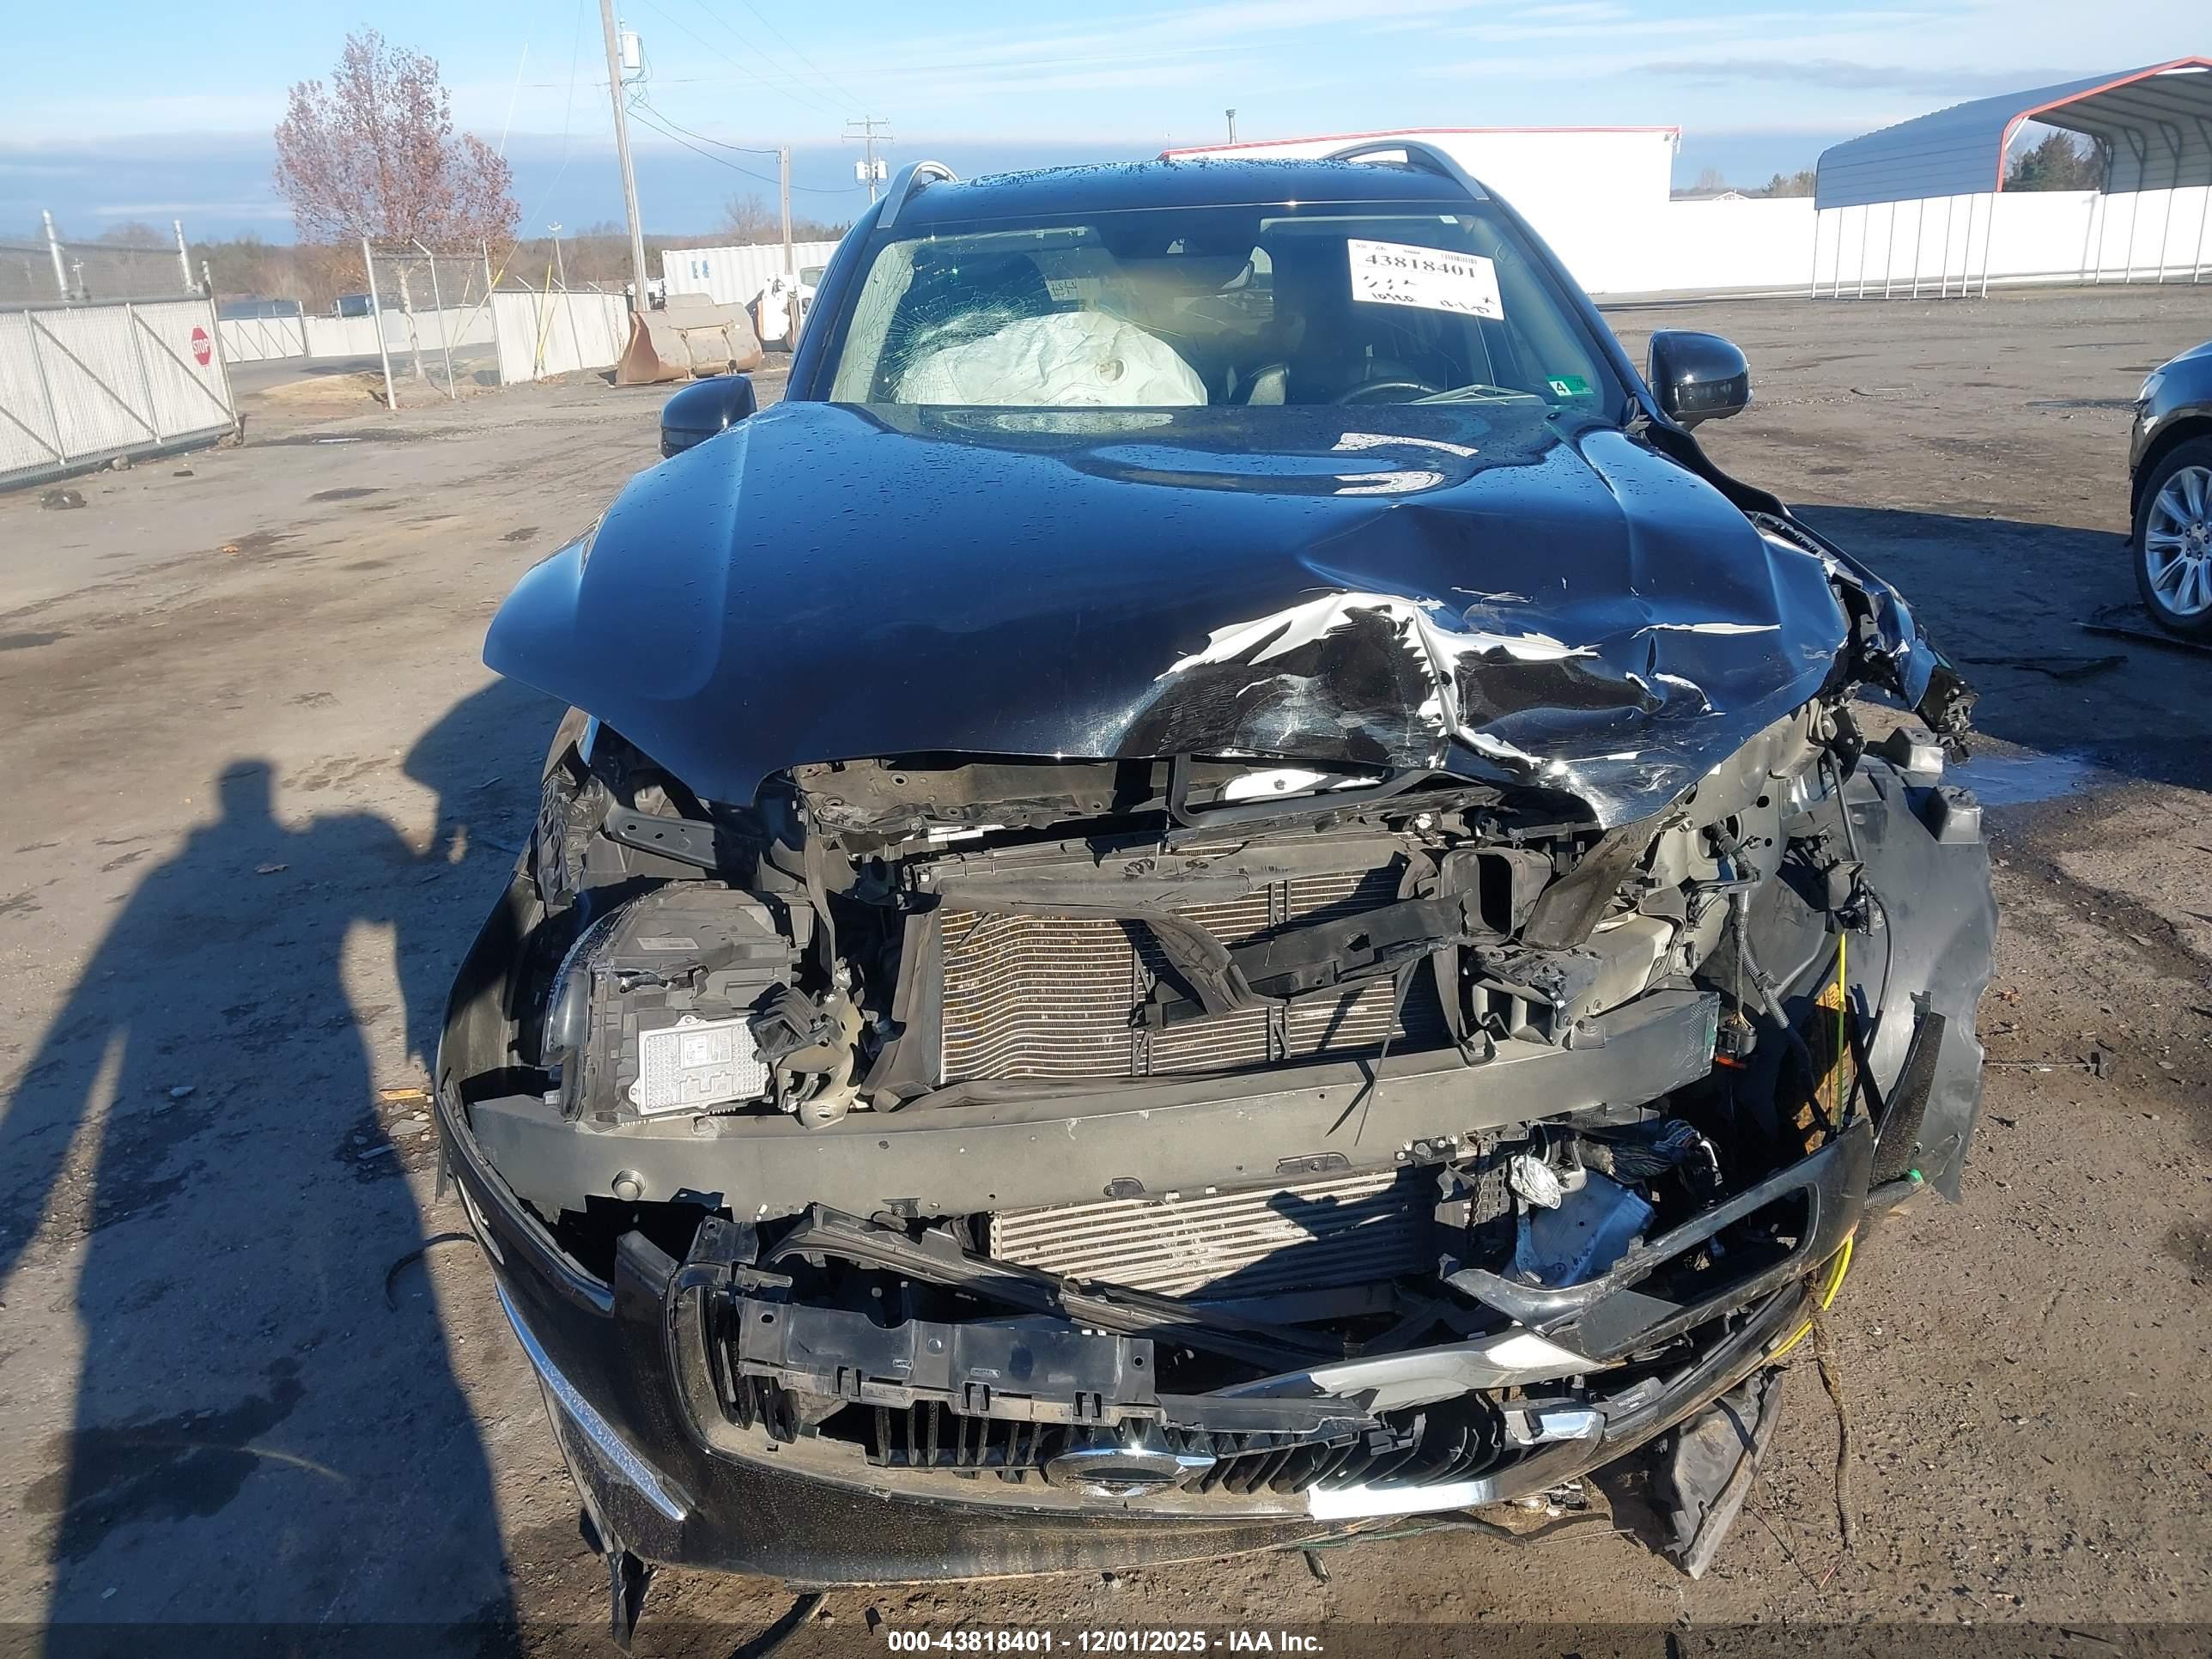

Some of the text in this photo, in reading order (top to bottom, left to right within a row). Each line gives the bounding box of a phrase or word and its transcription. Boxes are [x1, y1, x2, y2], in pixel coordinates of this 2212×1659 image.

[1365, 253, 1475, 278] 43818401
[192, 338, 210, 355] STOP
[1556, 381, 1567, 393] 4
